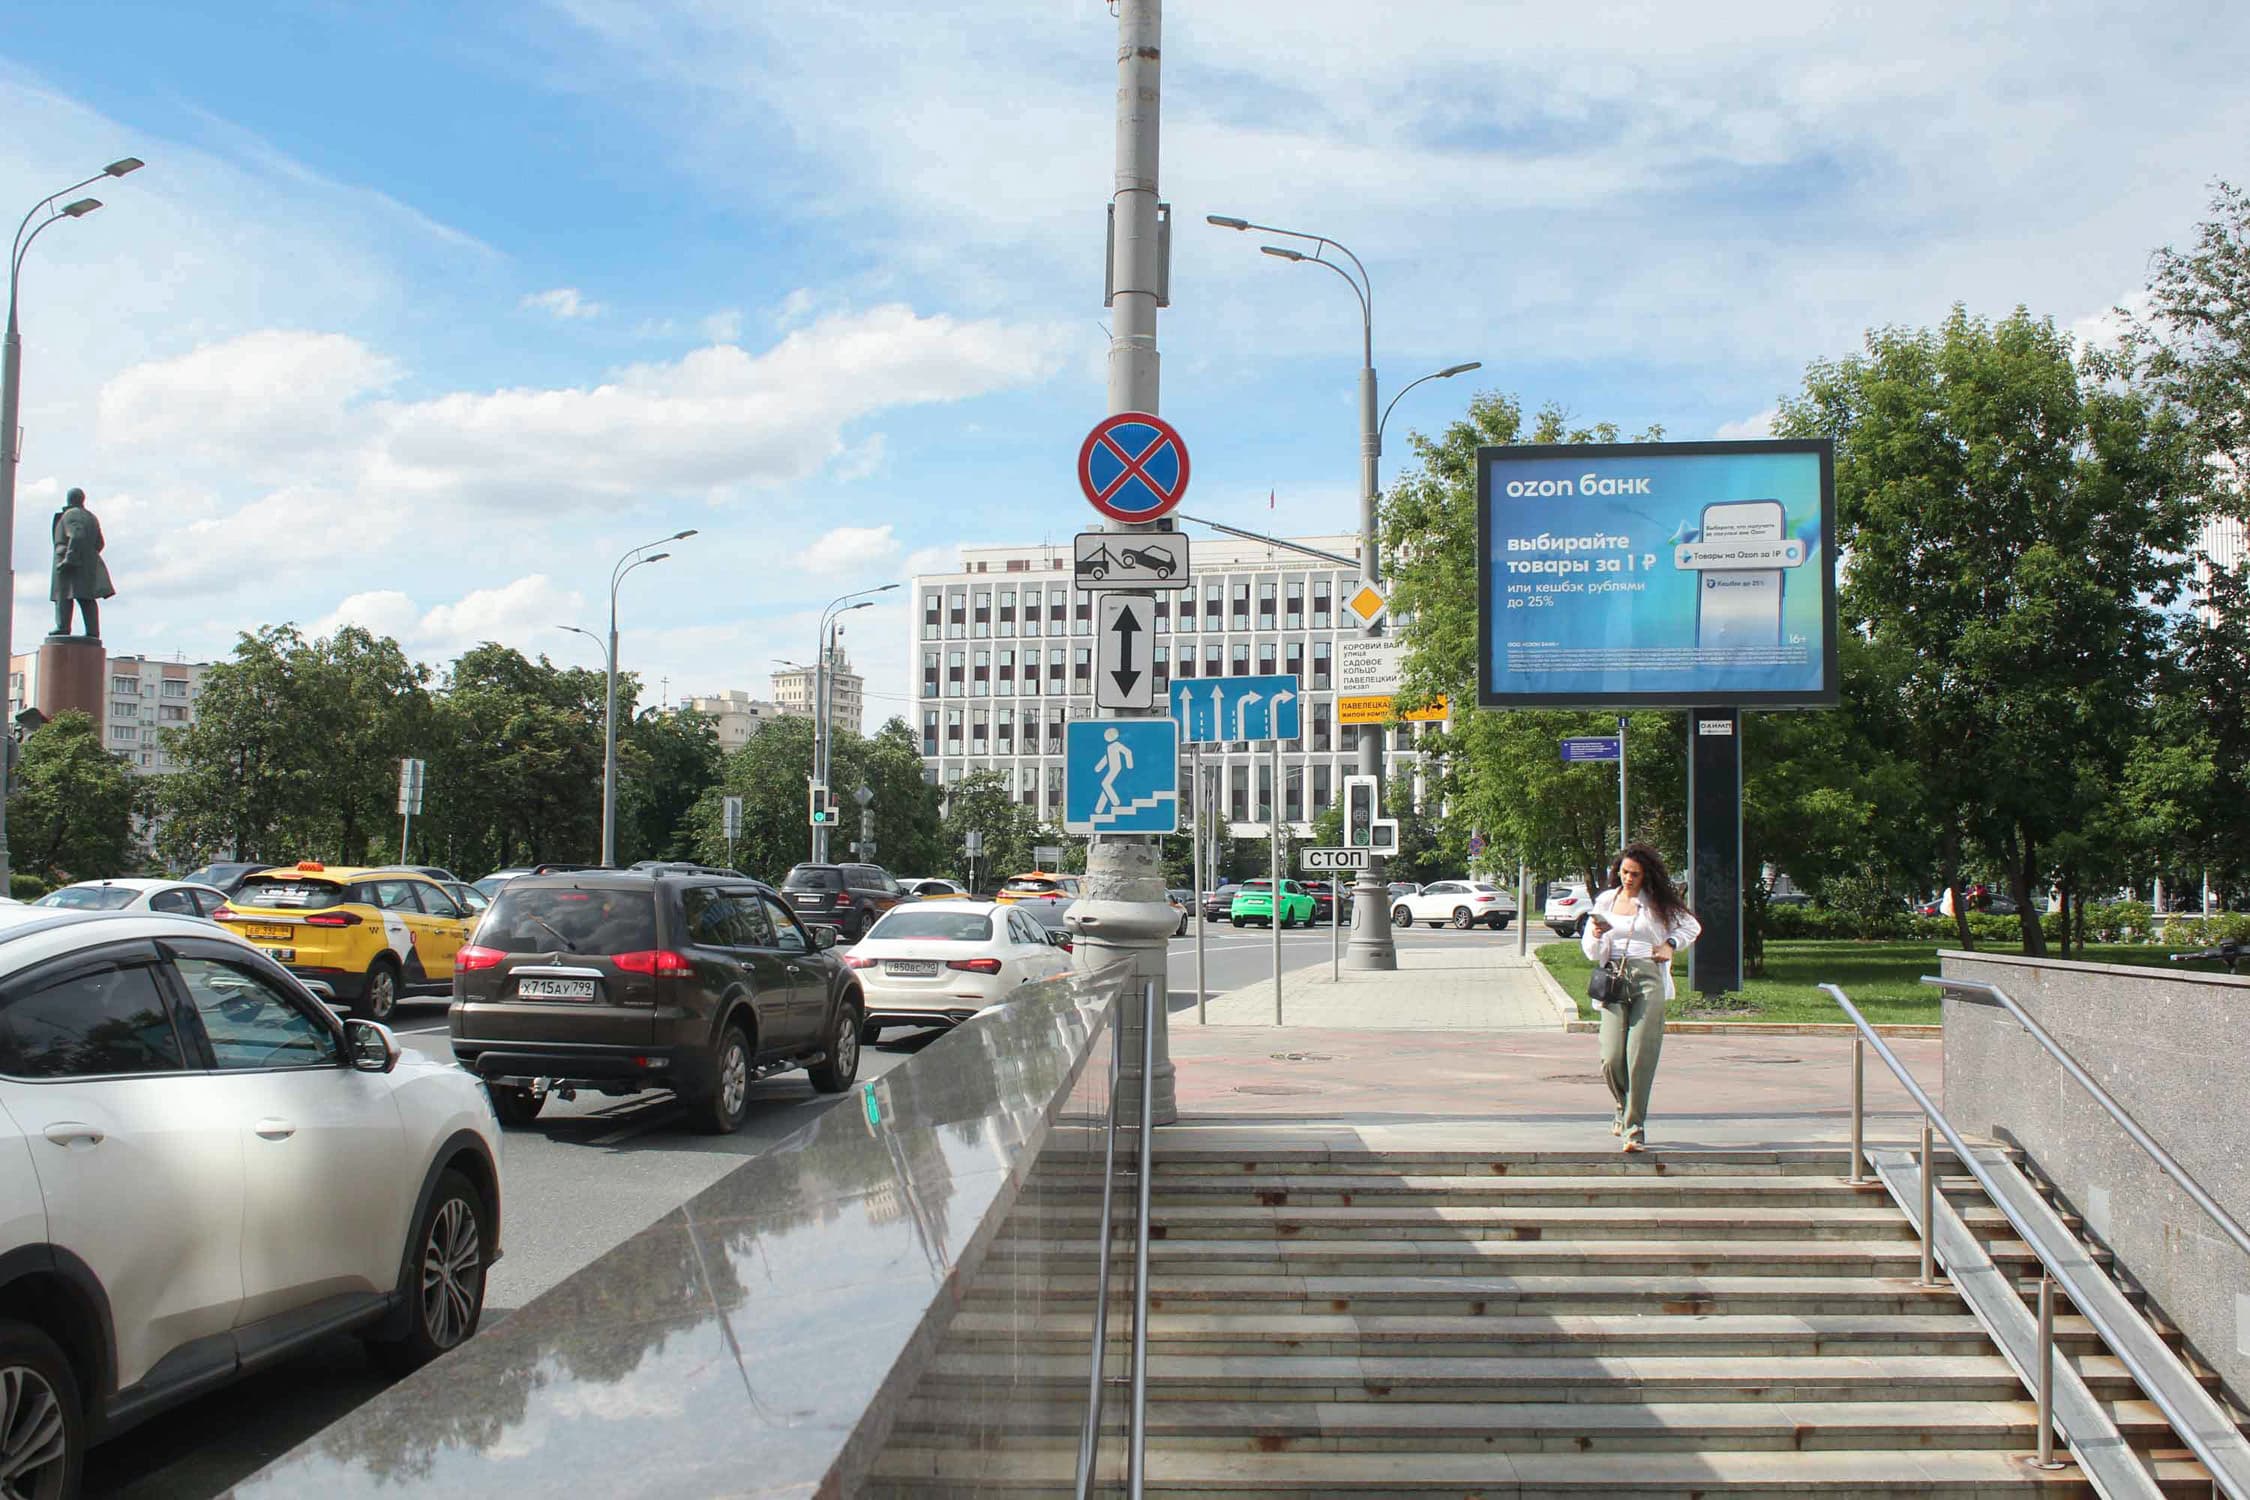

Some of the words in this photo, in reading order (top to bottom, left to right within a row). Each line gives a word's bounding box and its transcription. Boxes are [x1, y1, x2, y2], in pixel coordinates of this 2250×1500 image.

[1506, 480, 1573, 498] ozon
[1579, 473, 1651, 497] банк
[1507, 533, 1630, 553] выбирайте
[1694, 552, 1723, 561] Товары
[1737, 551, 1759, 559] Ozon
[1506, 558, 1589, 577] товары
[1595, 558, 1621, 573] за
[1627, 553, 1635, 573] 1
[1507, 584, 1532, 593] или
[1536, 581, 1584, 593] кешбэк
[1588, 580, 1646, 595] рублями
[1507, 598, 1524, 609] до
[1527, 596, 1555, 608] 25%
[1789, 633, 1807, 644] 16+
[1343, 642, 1382, 651] КОРОВИЙ
[1343, 658, 1383, 666] САДОВОЕ
[1343, 675, 1397, 684] ПАВЕЛЕЦКИЙ
[1310, 852, 1361, 867] СТОП
